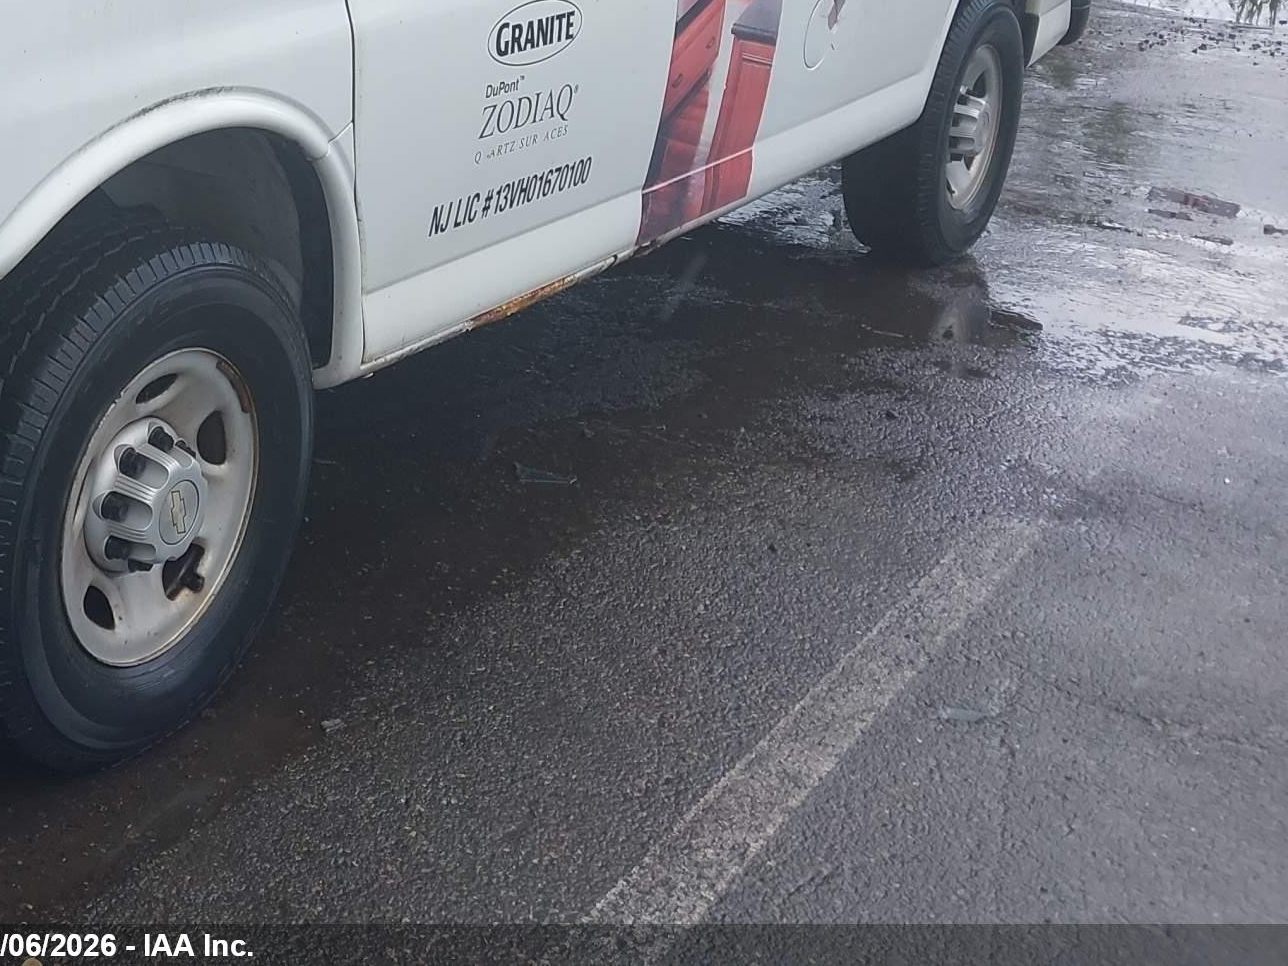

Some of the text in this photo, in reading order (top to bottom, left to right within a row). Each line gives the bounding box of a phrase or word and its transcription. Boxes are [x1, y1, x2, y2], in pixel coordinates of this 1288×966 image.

[495, 10, 576, 57] GRANITE
[429, 202, 453, 237] NJ
[453, 192, 481, 229] LIC
